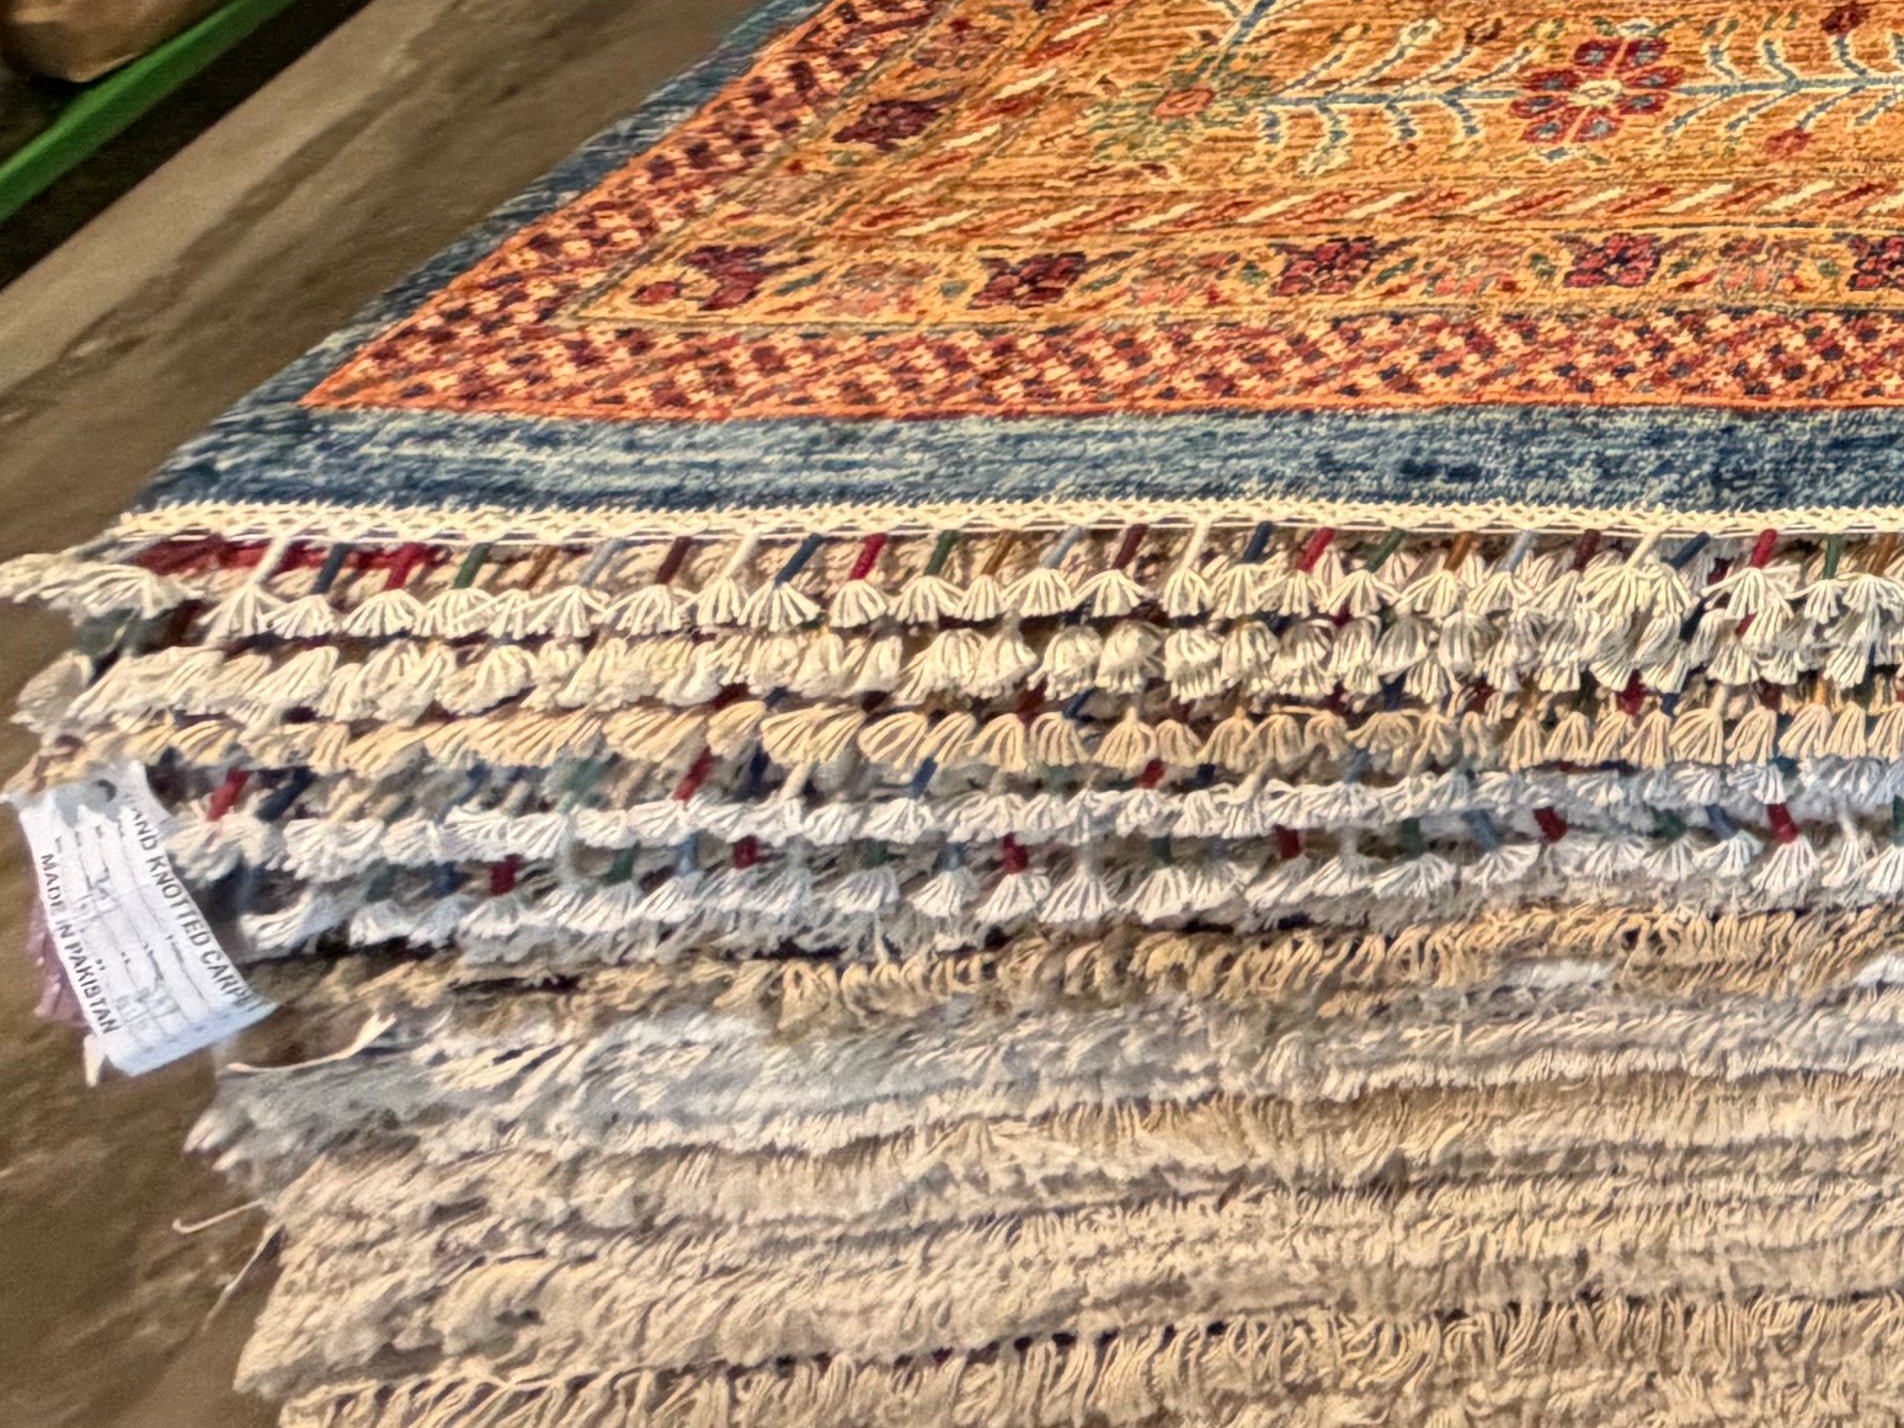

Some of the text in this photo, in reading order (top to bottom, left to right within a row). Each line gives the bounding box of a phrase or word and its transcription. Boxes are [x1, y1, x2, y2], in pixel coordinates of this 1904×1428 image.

[40, 852, 122, 1035] MADE IN PAKISTAN
[146, 854, 211, 946] KNOTTED
